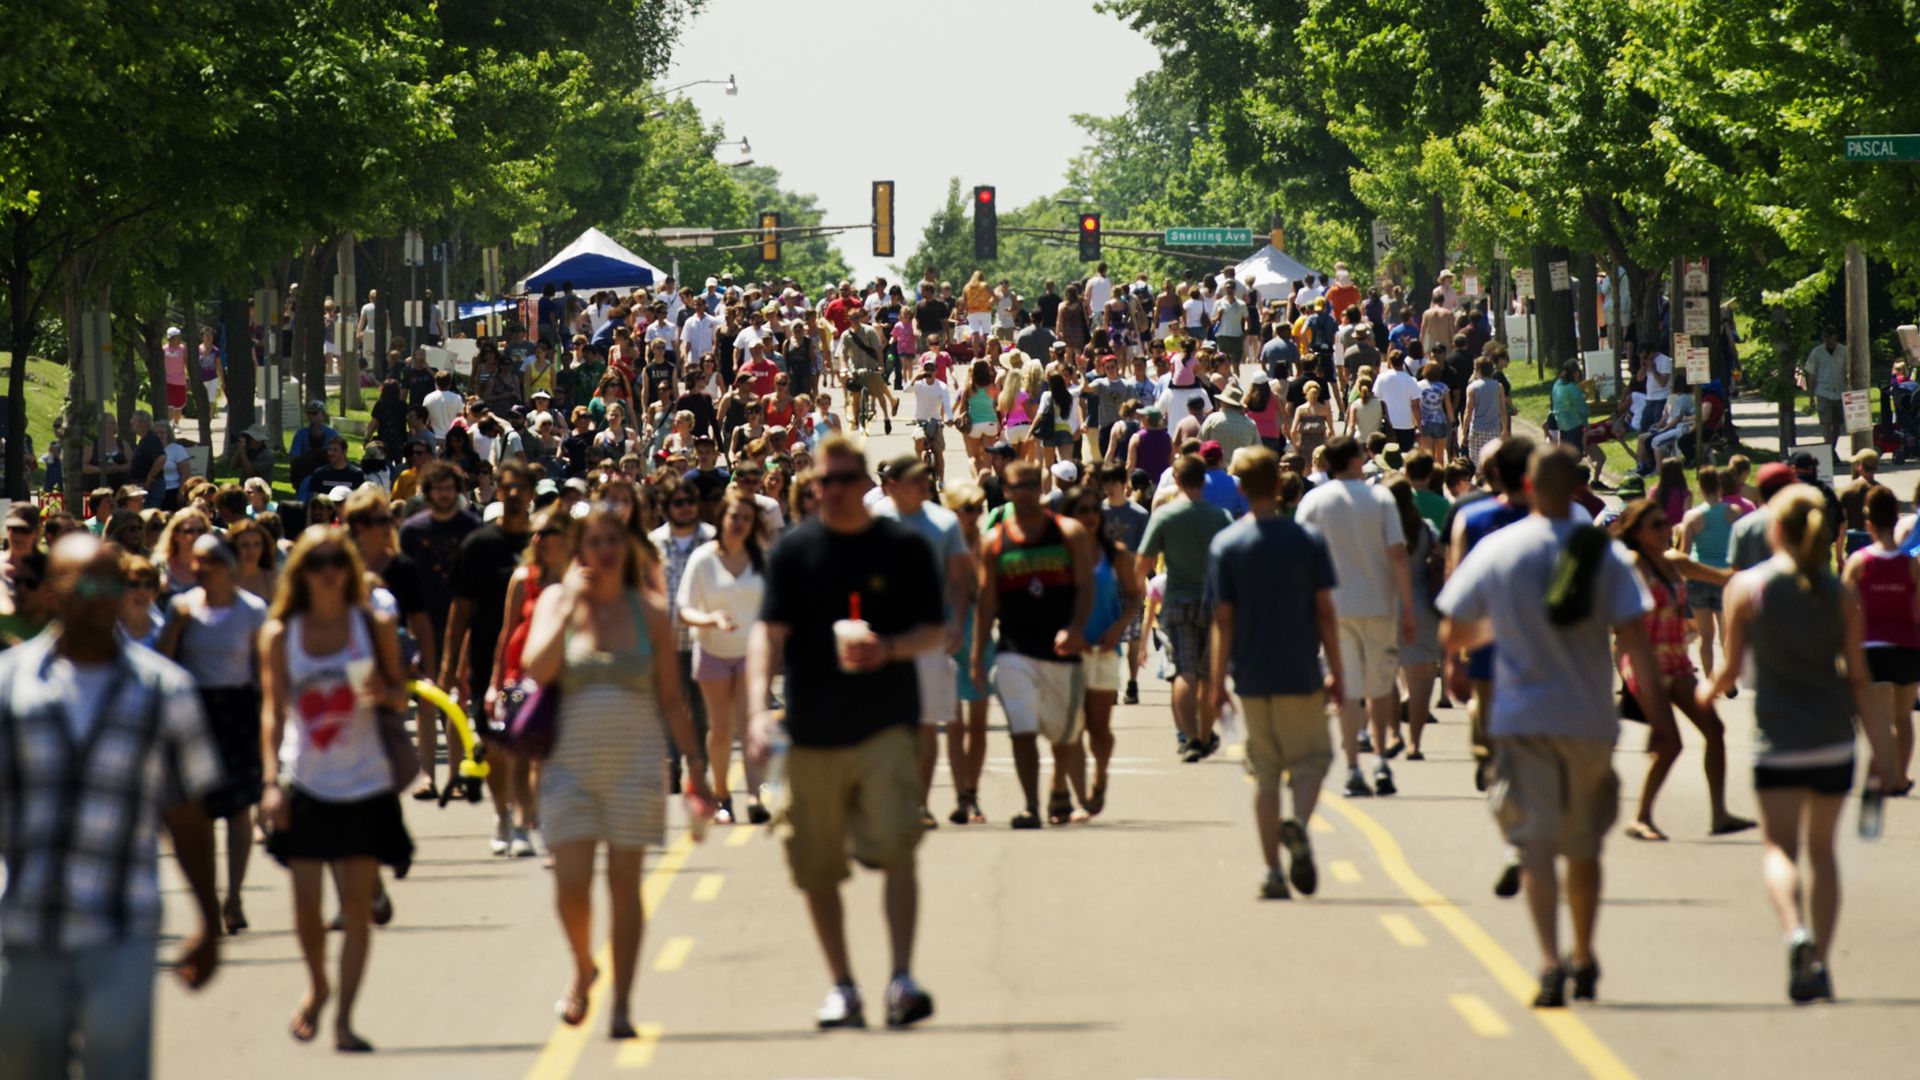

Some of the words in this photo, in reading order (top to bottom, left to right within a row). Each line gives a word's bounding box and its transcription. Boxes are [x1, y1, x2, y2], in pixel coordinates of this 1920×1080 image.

[1847, 140, 1898, 156] PASCAL
[1171, 231, 1222, 242] Snelling
[1225, 230, 1247, 241] Ave
